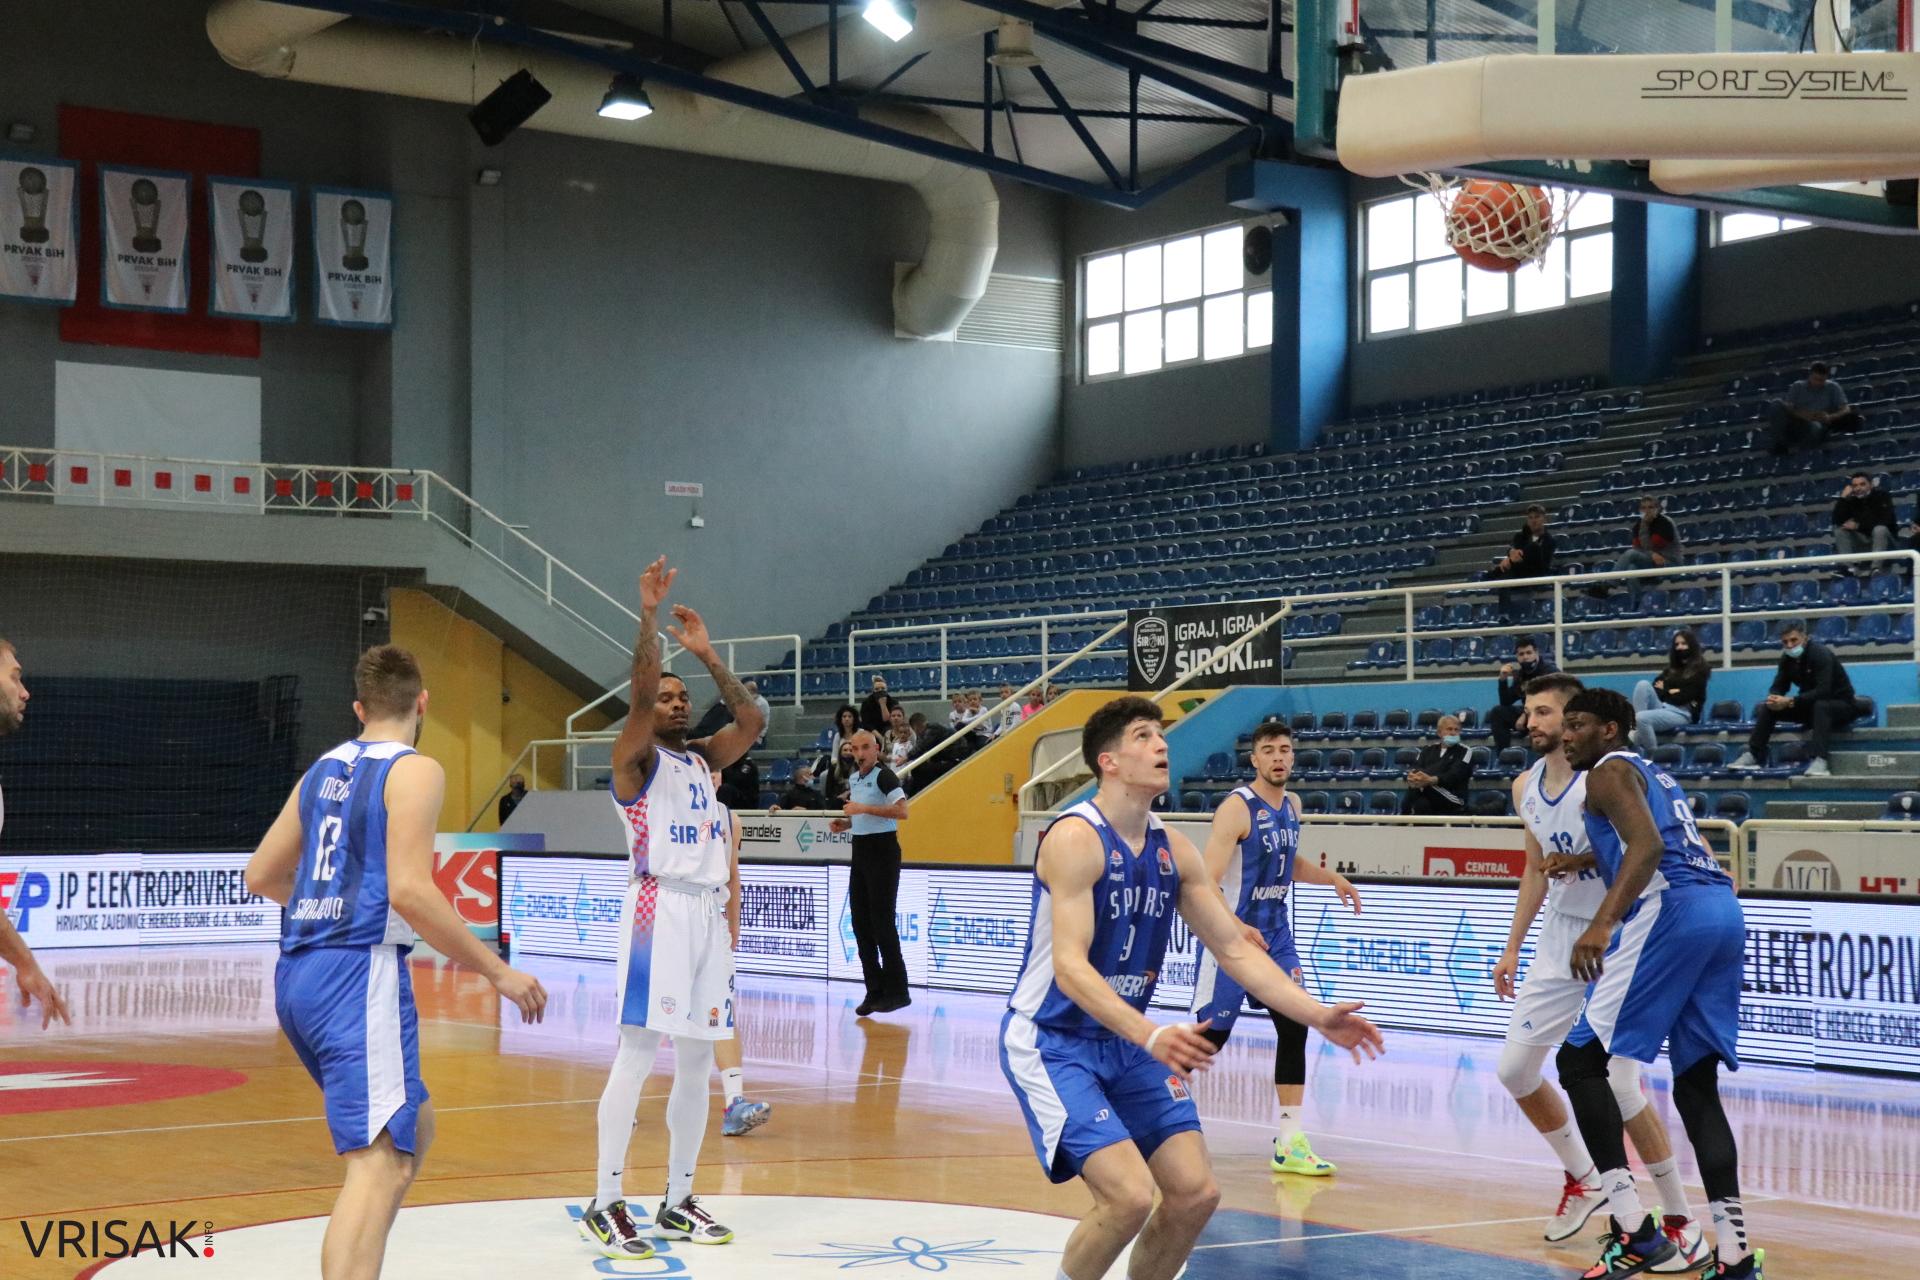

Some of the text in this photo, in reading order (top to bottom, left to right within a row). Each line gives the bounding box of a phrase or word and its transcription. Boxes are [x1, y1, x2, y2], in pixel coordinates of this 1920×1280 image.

[1642, 70, 1759, 91] SPORT
[4, 244, 42, 256] PRVAK
[118, 254, 153, 265] PRVAK
[226, 264, 260, 275] PRVAK
[328, 272, 362, 284] PRVAK
[1175, 619, 1219, 642] IGRAJ,
[1262, 828, 1298, 853] SPARS
[1465, 861, 1510, 873] CENTRAL
[57, 871, 79, 909] JP
[593, 897, 623, 922] EMER
[56, 914, 98, 932] HRVATSKE
[101, 912, 145, 931] ZAJEDNICE
[954, 915, 1016, 947] EMERUS
[1346, 937, 1431, 975] EMERUS
